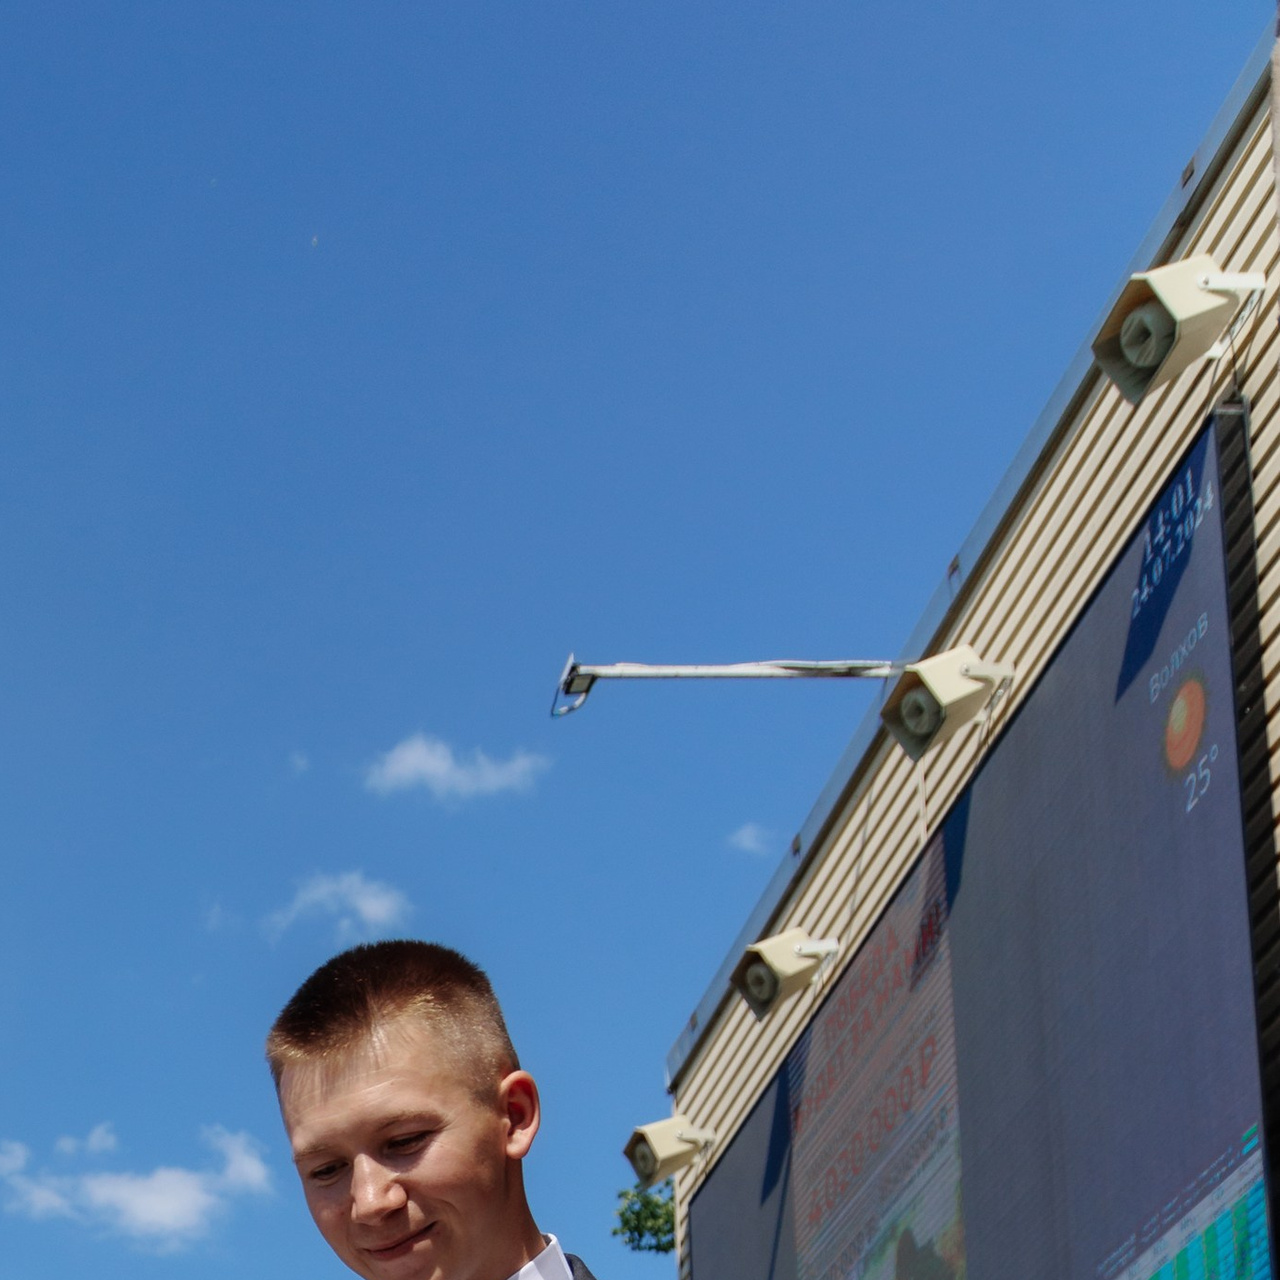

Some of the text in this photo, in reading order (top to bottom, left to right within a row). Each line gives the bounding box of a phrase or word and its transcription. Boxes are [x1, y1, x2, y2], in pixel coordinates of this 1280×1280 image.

[1131, 479, 1214, 620] 24.07.2024
[1144, 467, 1195, 567] 14:01
[1149, 611, 1209, 704] Волхов
[1184, 744, 1219, 813] 25°
[825, 923, 899, 1050] ПОБЕДА
[852, 1008, 873, 1056] ЗА
